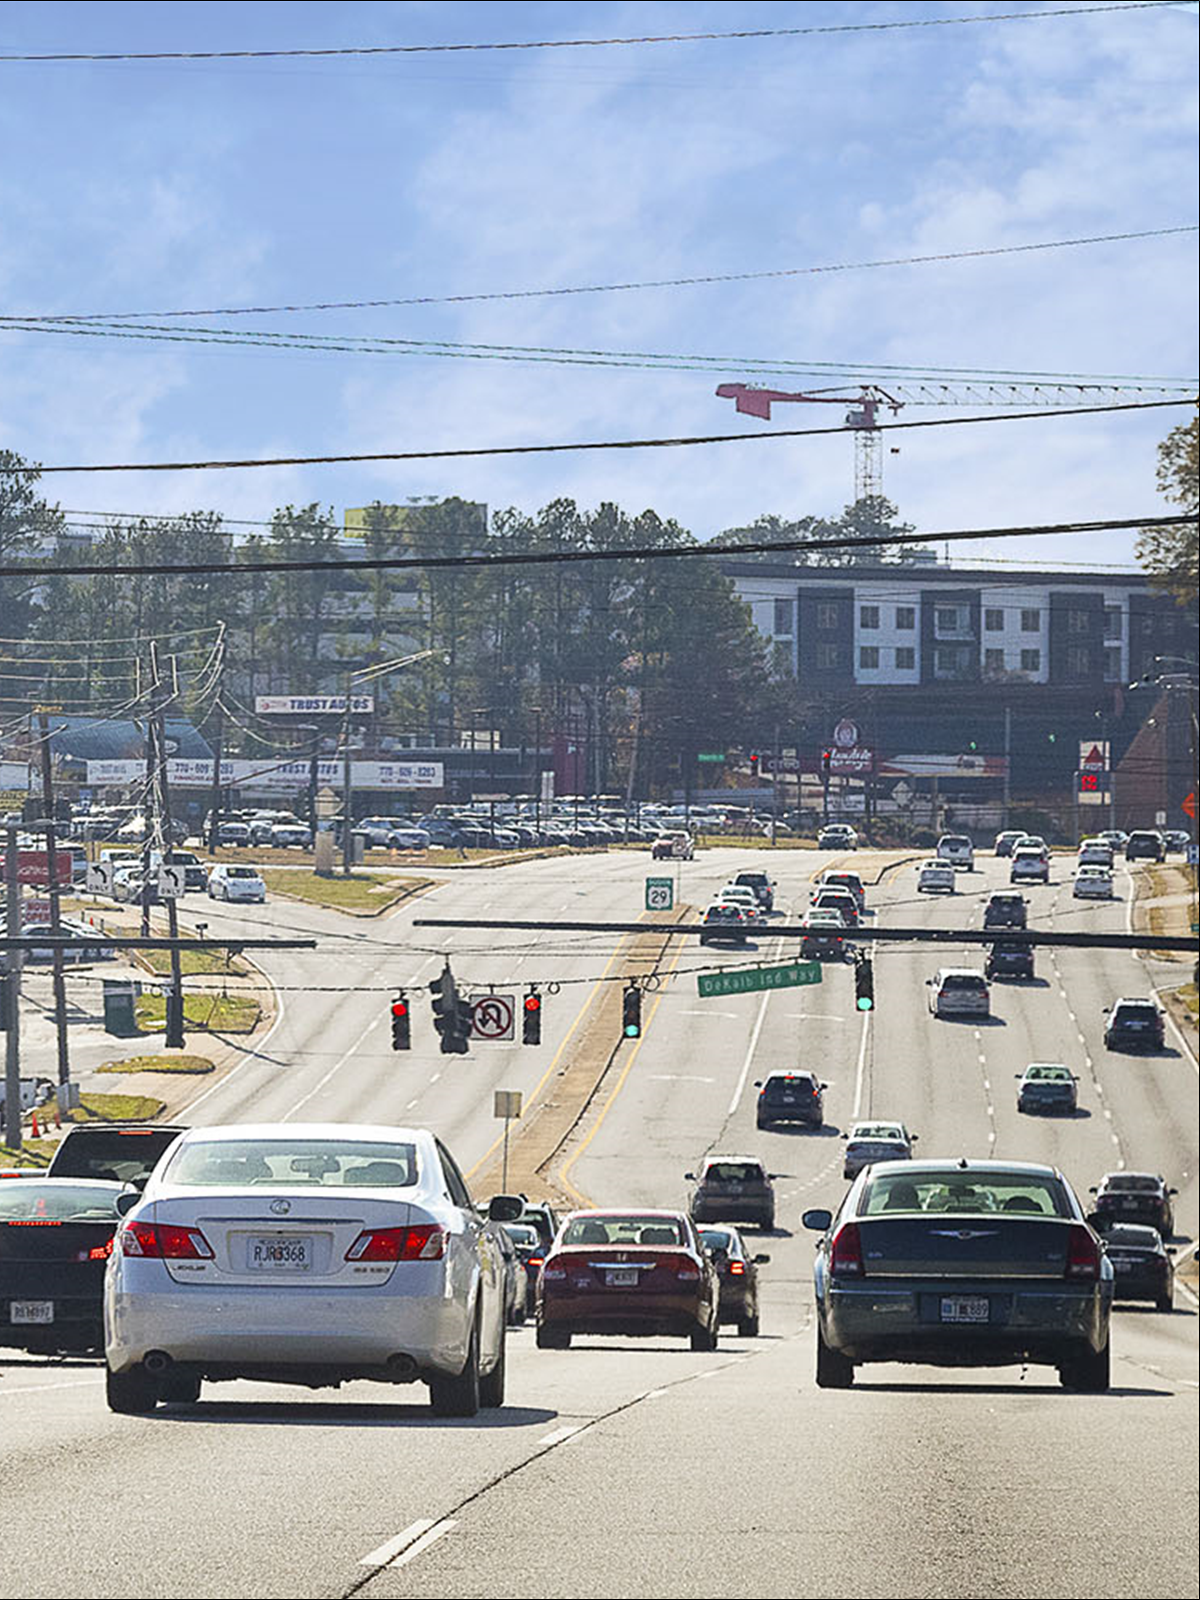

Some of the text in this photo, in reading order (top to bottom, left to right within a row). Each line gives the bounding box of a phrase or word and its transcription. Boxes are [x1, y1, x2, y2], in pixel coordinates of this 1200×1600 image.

[290, 699, 327, 710] TRUST
[329, 699, 369, 710] AUOS
[88, 883, 109, 892] ONLY
[160, 887, 181, 896] ONLY
[651, 890, 667, 904] 29
[703, 969, 816, 992] DeKalb Ind Way
